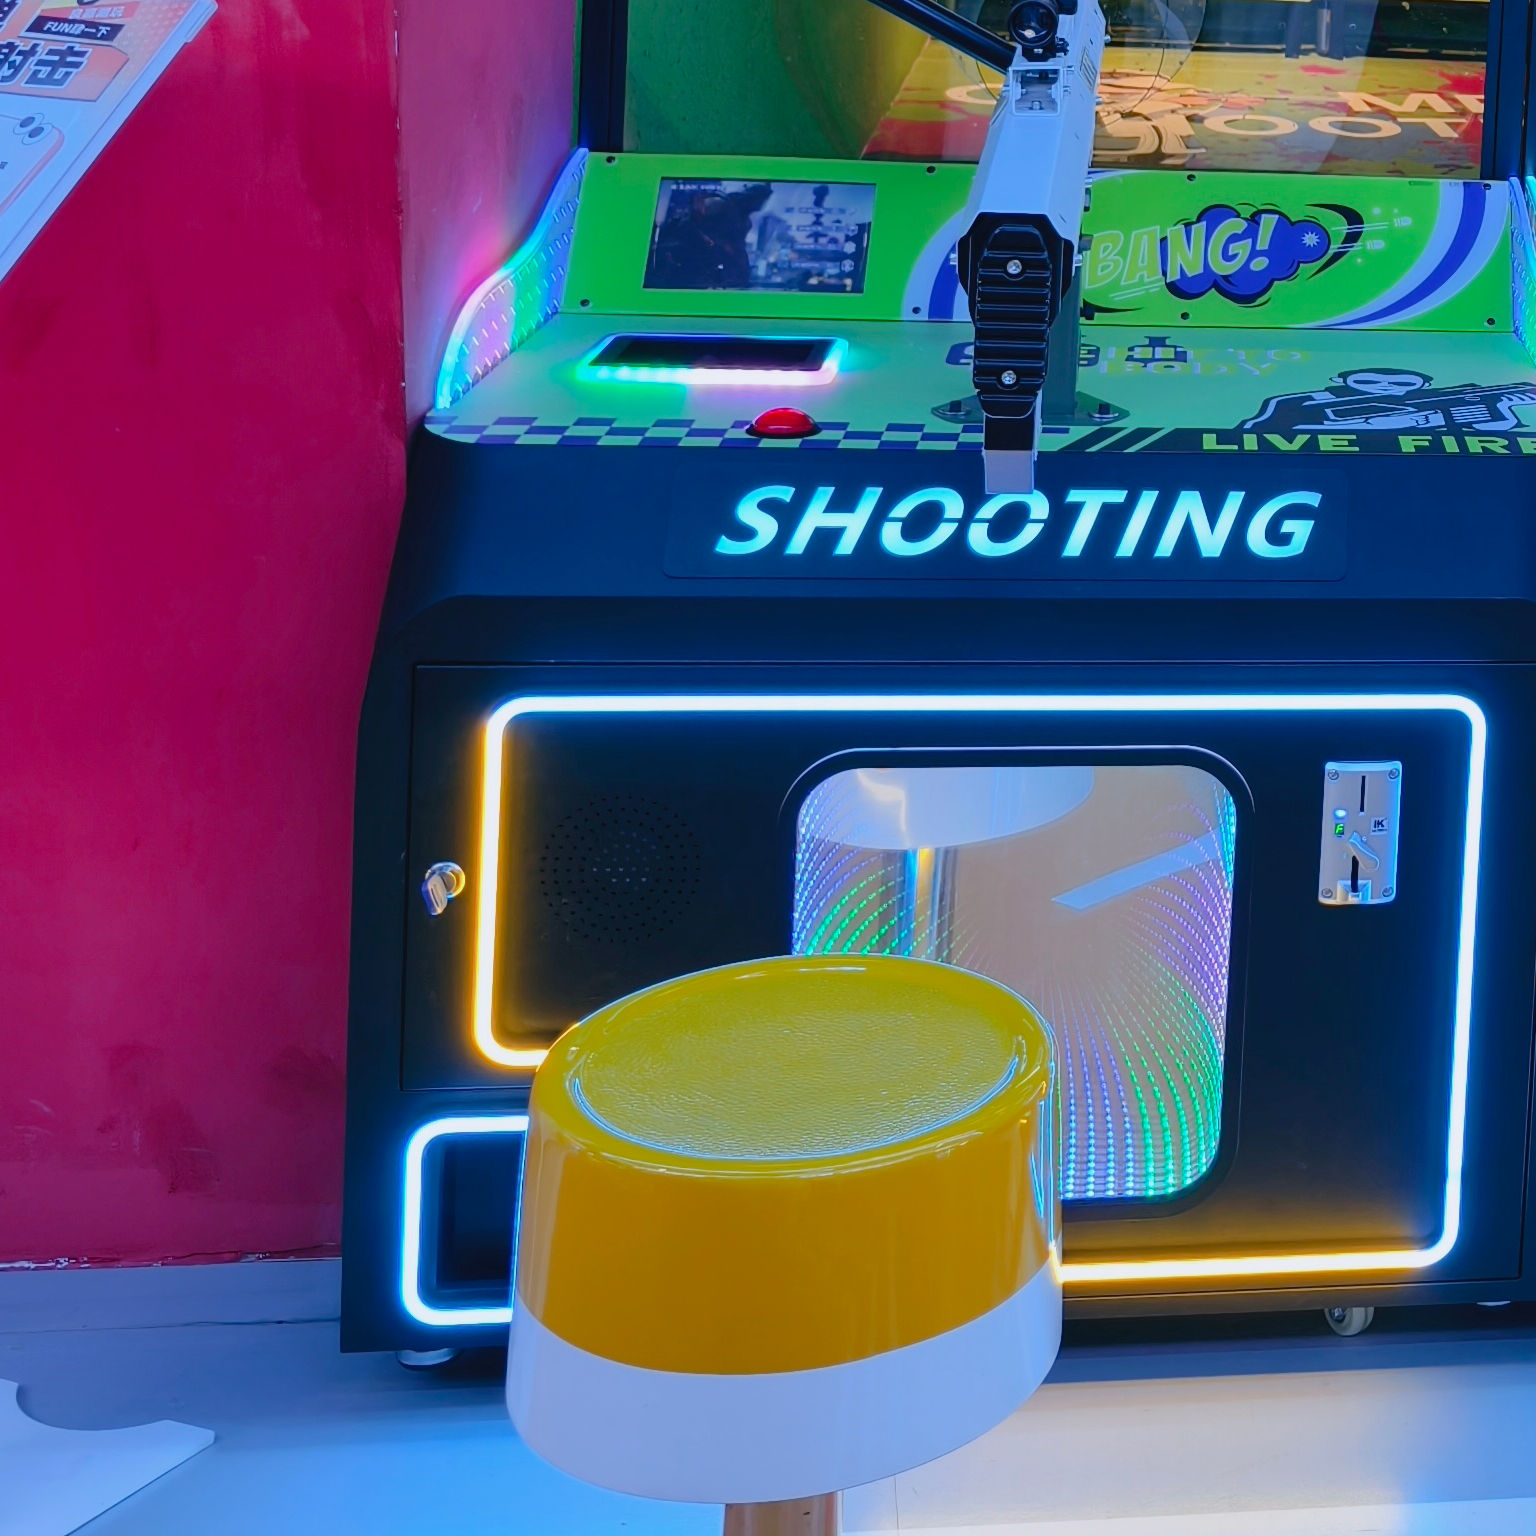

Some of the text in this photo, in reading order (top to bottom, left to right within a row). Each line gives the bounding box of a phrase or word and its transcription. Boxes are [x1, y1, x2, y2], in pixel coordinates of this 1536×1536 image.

[1084, 214, 1280, 289] BANG!
[1202, 433, 1361, 452] LIVE
[715, 485, 1322, 559] SHOOTING
